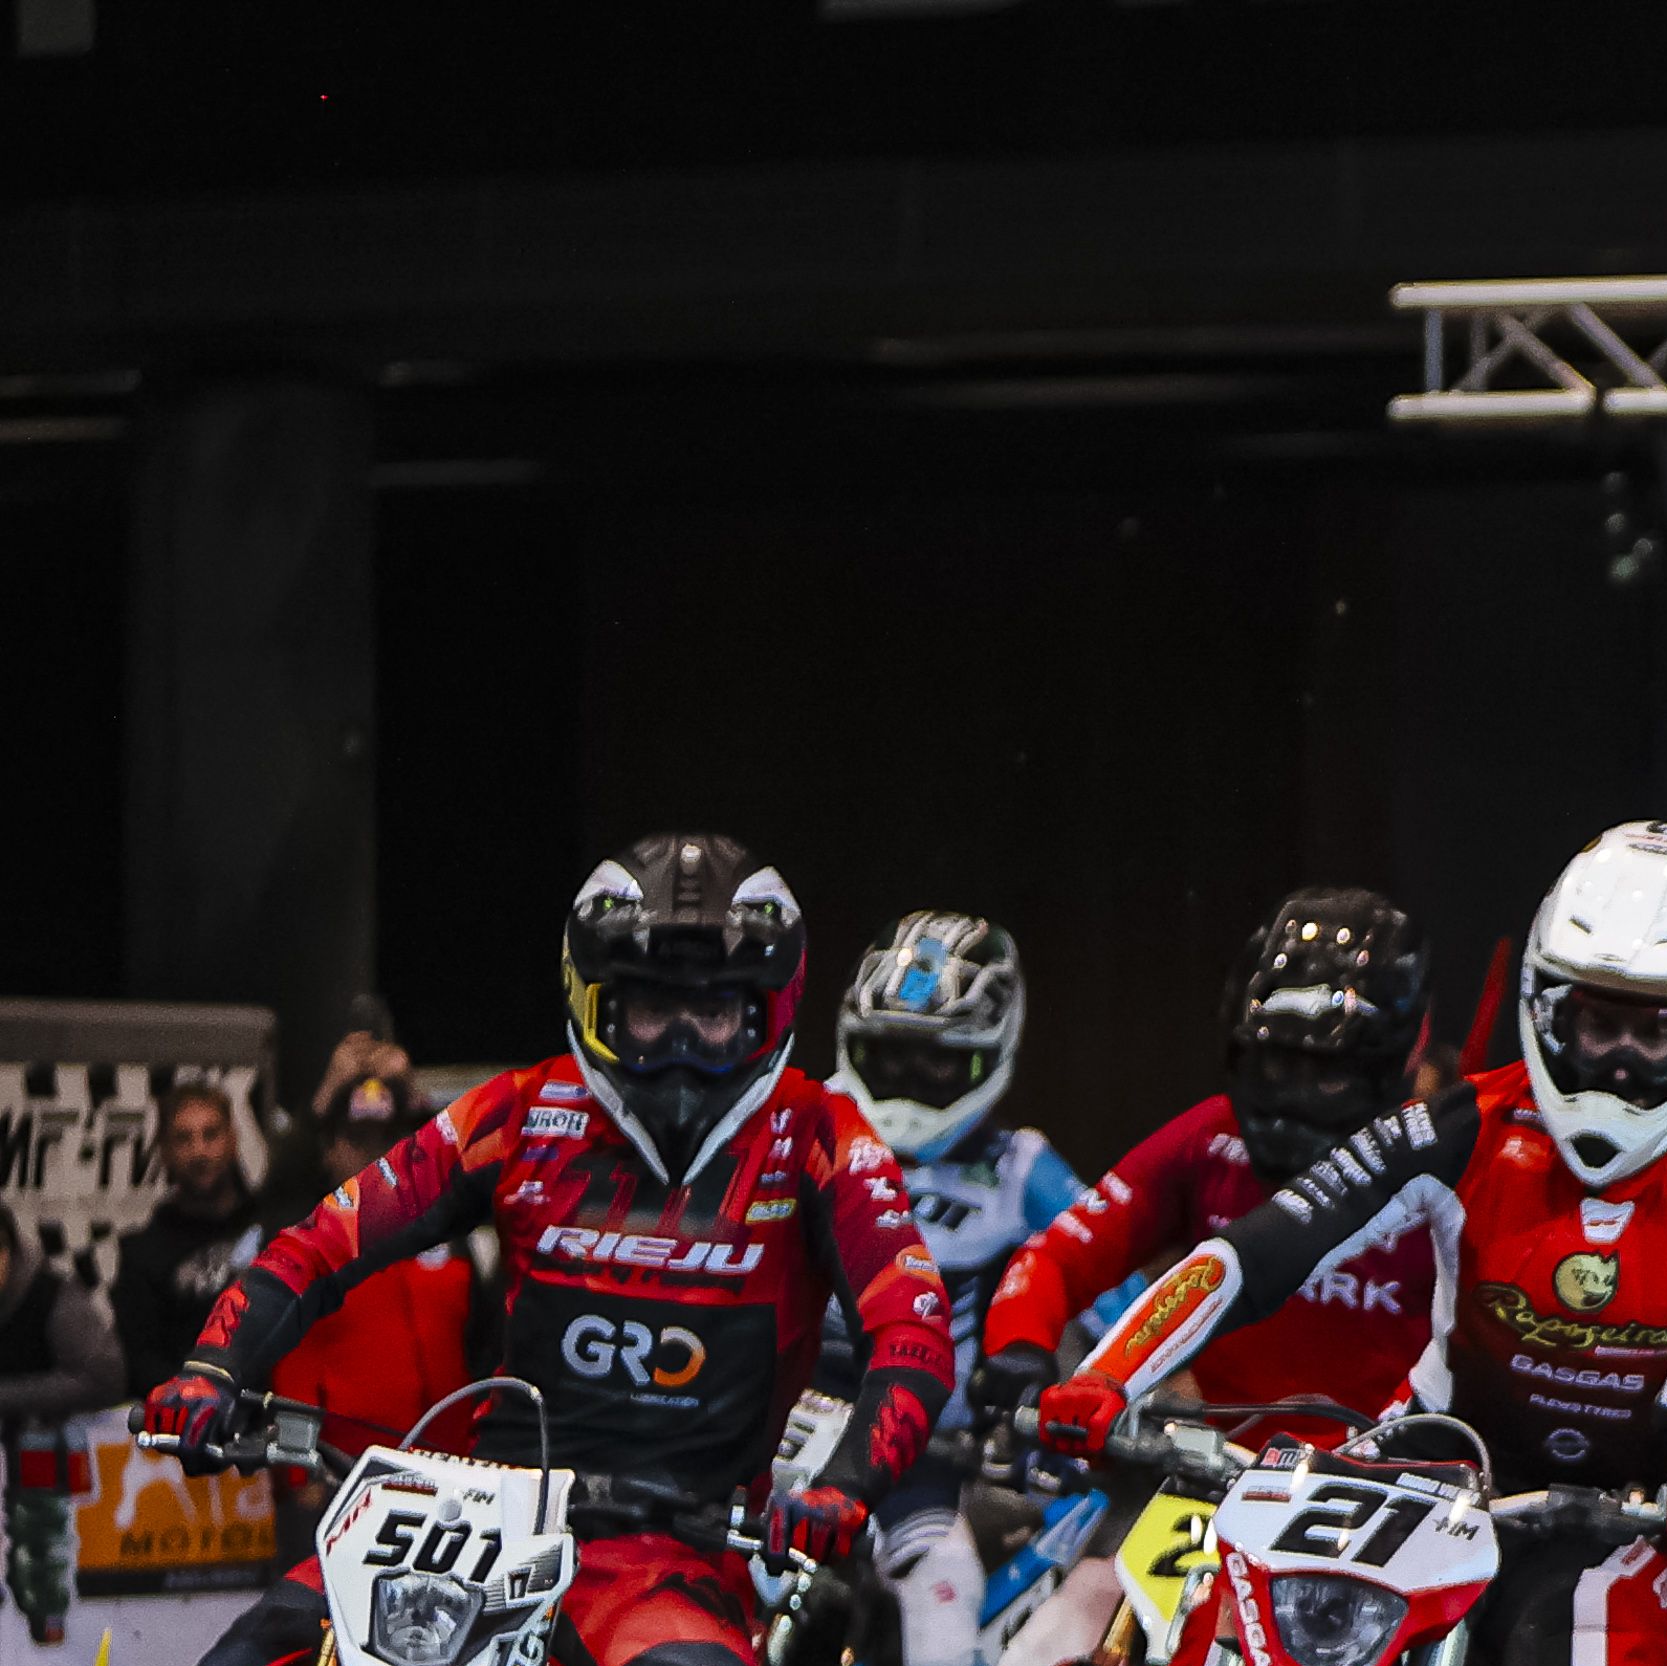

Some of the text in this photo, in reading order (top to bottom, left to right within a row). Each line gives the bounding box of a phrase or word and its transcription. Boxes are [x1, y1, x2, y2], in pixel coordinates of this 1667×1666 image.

[536, 1223, 765, 1272] RIEJU
[1510, 1353, 1646, 1392] GASGAS
[362, 1507, 503, 1584] 501
[1268, 1480, 1438, 1568] 21
